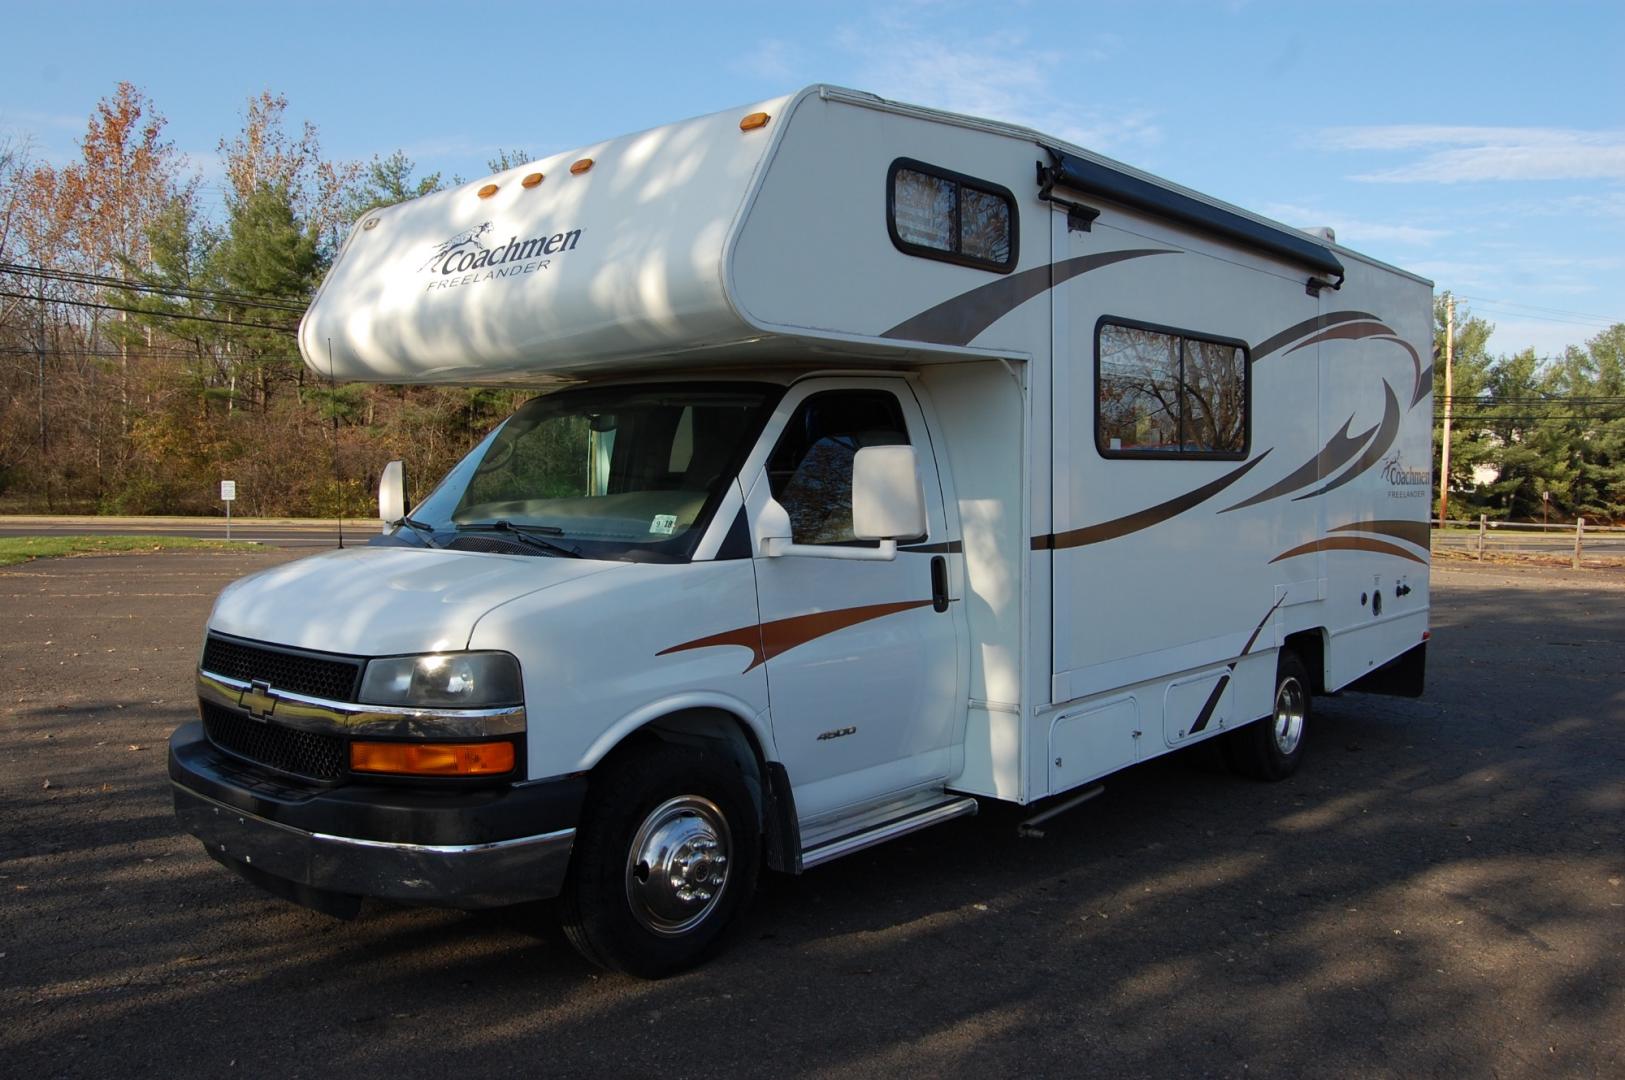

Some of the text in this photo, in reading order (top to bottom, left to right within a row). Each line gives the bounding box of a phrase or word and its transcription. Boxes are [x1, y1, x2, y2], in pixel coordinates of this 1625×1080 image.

[442, 228, 582, 275] Coachmen
[427, 260, 551, 292] FREELANDER
[1390, 466, 1430, 485] Coachmen
